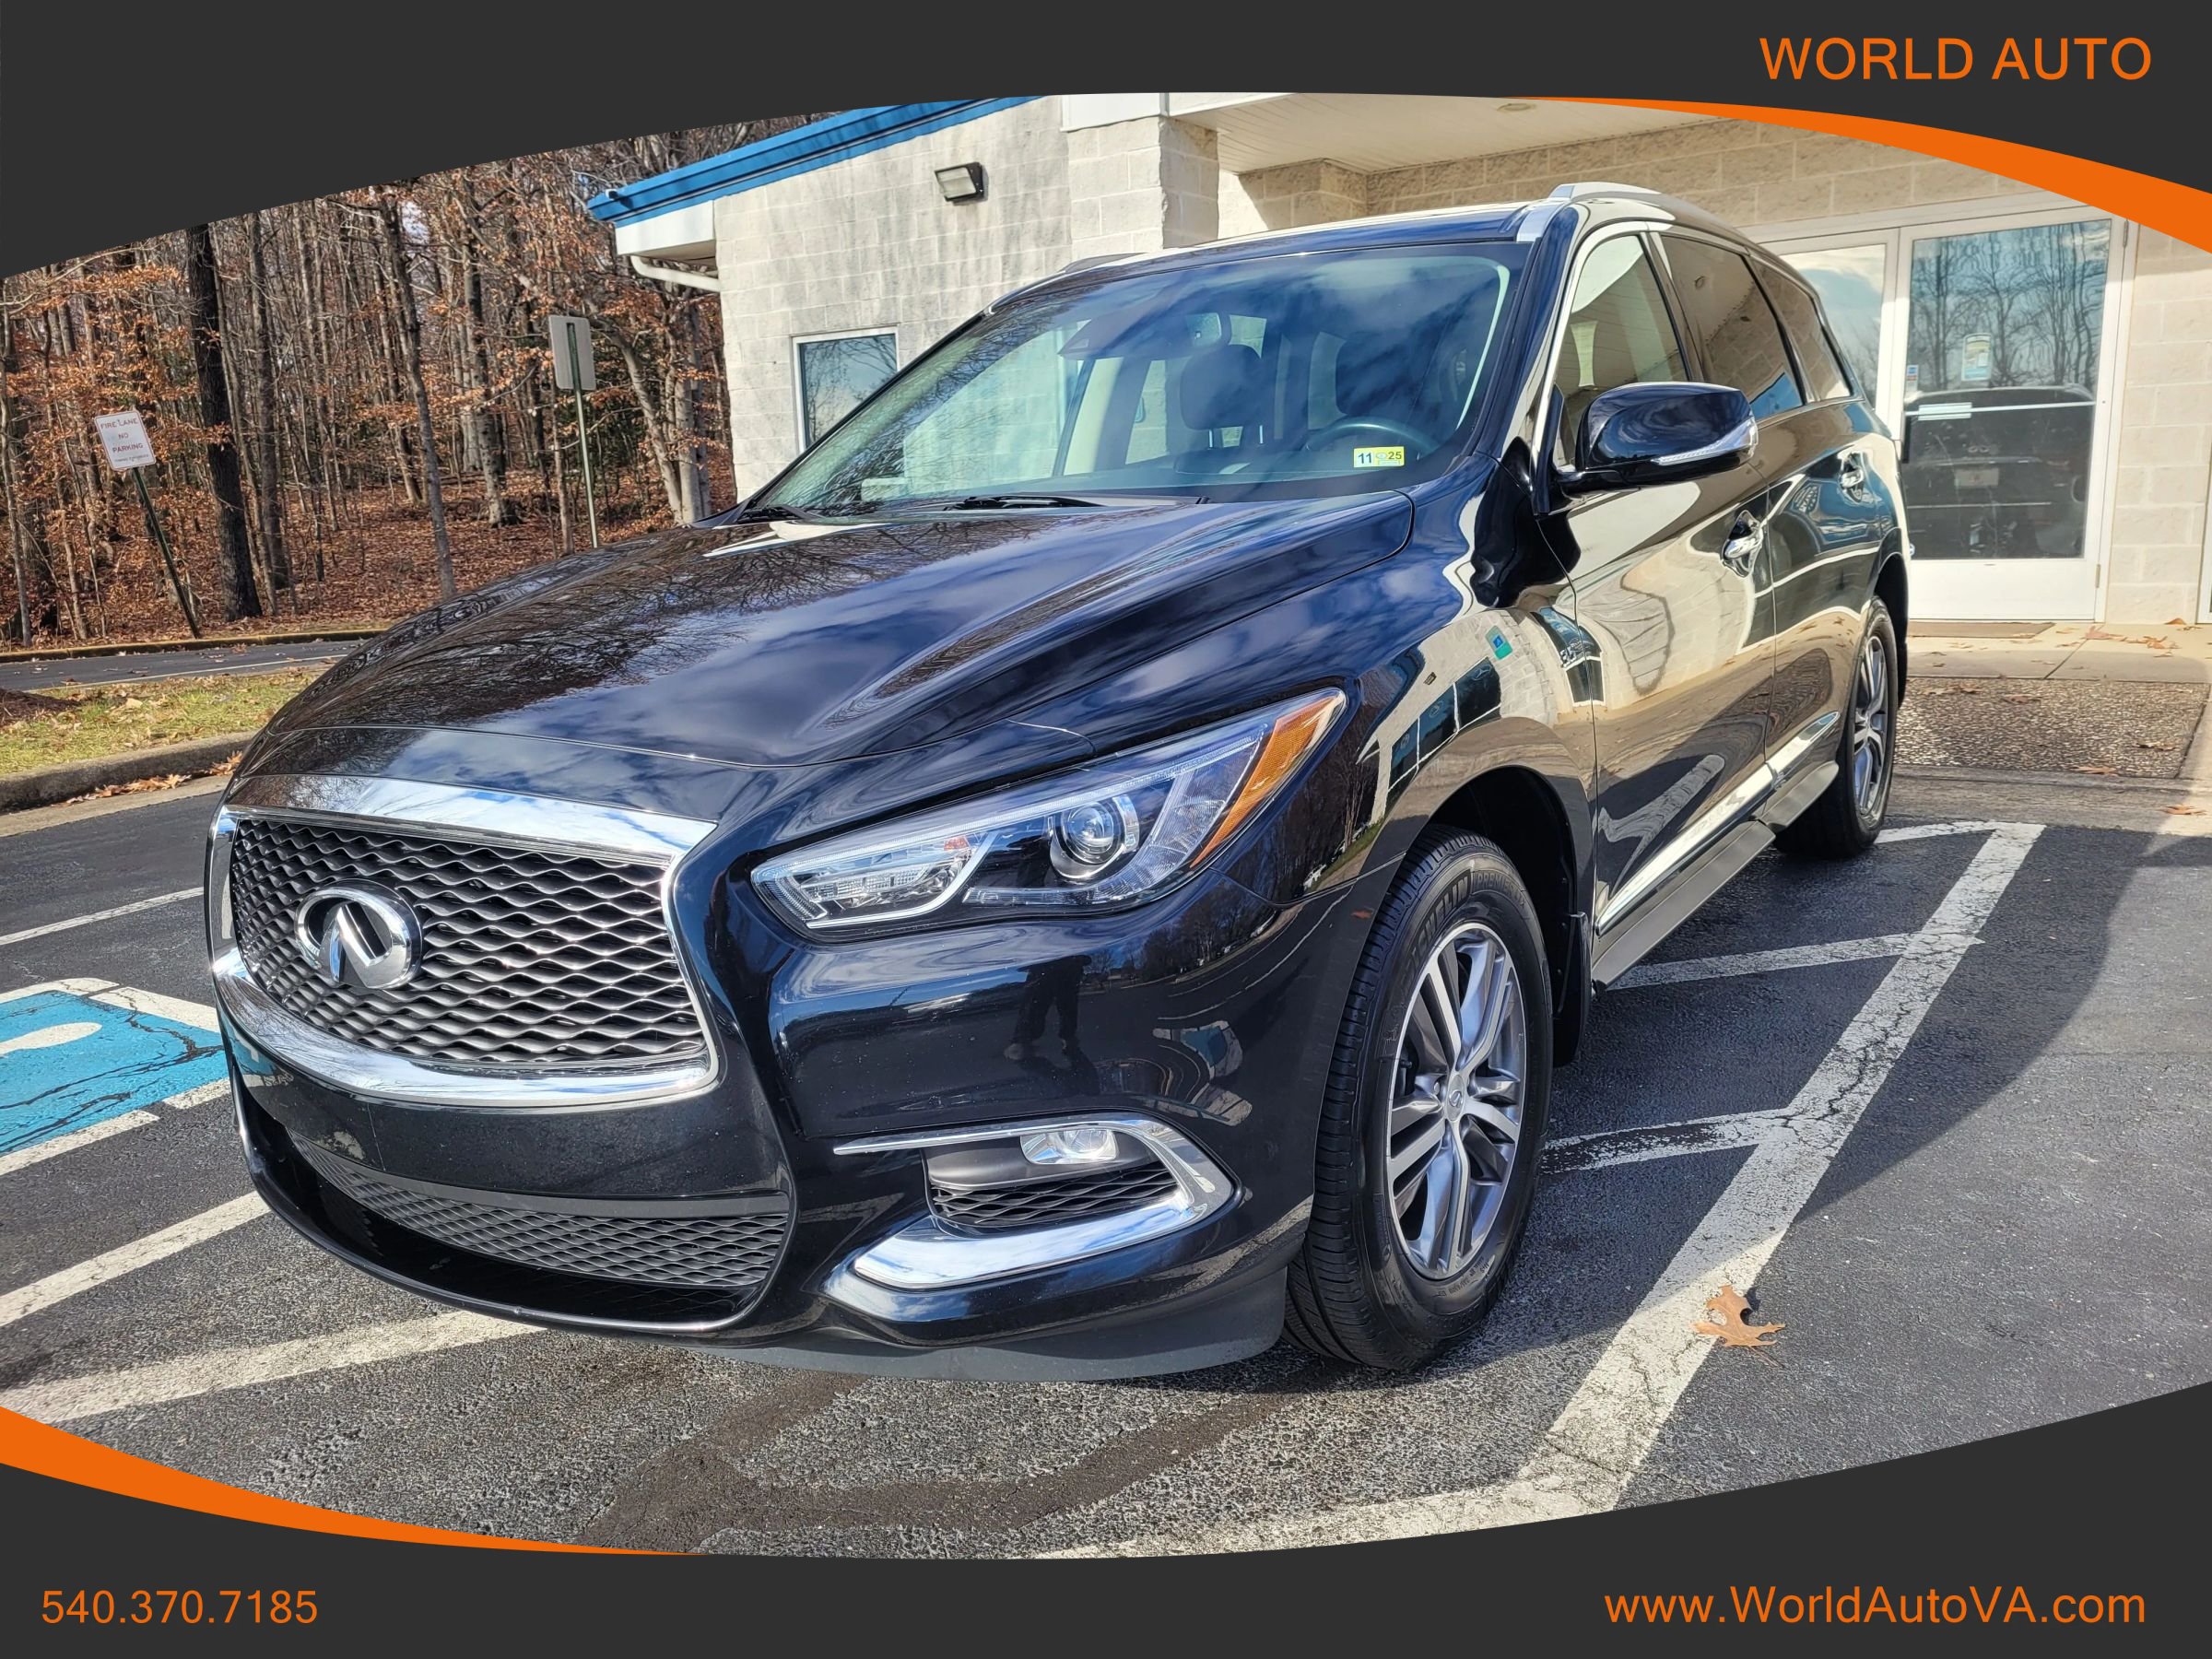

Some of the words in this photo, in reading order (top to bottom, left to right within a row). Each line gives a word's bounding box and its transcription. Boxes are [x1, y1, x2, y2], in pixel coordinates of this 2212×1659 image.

[100, 421, 117, 429] FIRE
[118, 418, 139, 427] LANE
[112, 442, 144, 453] PARKING
[1358, 453, 1371, 464] 11
[1388, 451, 1402, 460] 25
